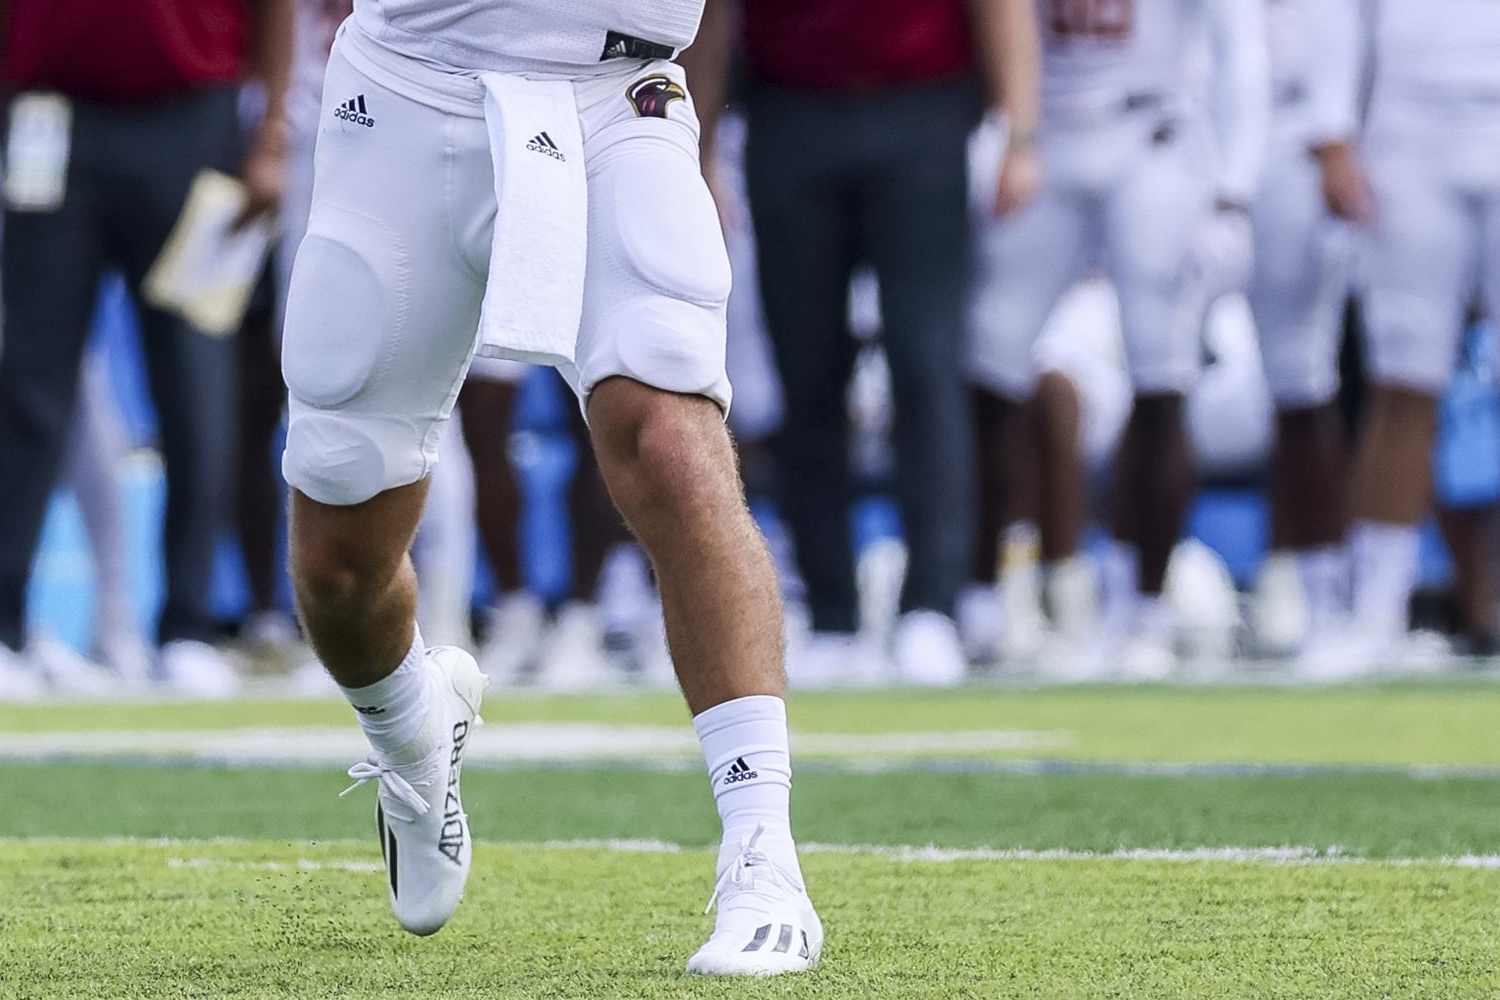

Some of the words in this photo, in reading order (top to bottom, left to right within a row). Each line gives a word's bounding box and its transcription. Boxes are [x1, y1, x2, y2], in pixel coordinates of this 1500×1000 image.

[334, 106, 376, 128] adidas
[525, 142, 567, 163] adidas
[723, 770, 758, 785] adidas
